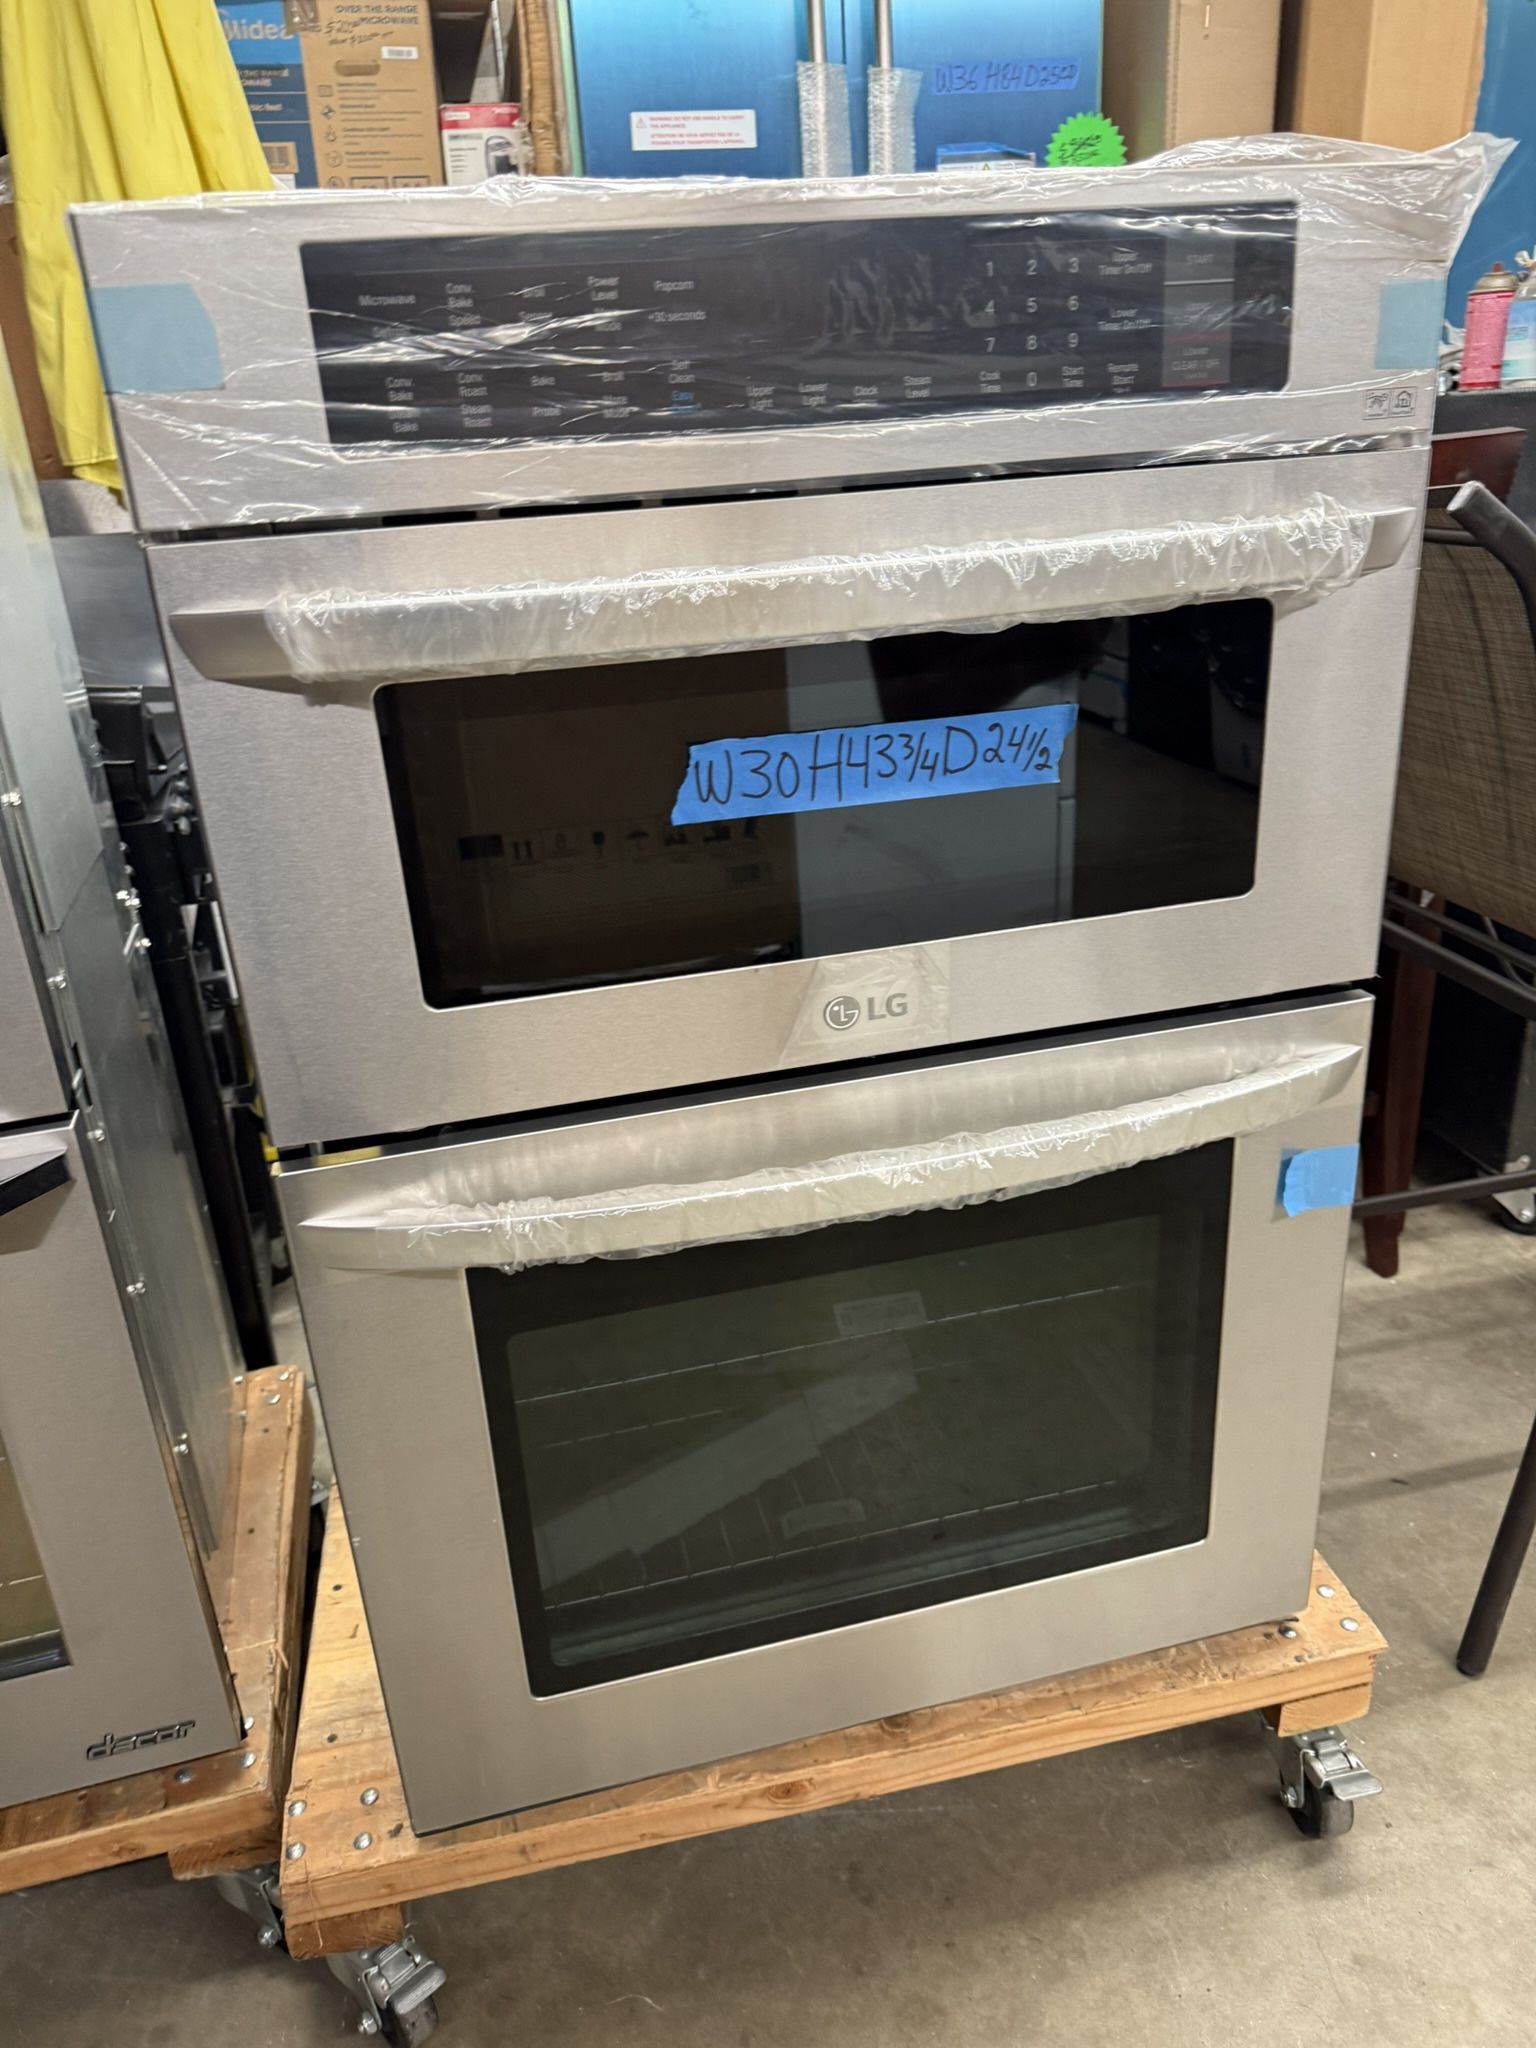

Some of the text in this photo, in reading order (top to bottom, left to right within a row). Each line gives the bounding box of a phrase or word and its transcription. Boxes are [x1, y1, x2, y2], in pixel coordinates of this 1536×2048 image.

[985, 257, 1080, 277] 1 2 3
[587, 276, 619, 287] Power
[654, 281, 695, 292] Popcorn
[358, 295, 416, 306] Microwave
[590, 289, 618, 301] Level
[448, 297, 474, 307] Bake
[984, 295, 1080, 313] 4 5 6
[668, 309, 707, 322] seconds
[984, 332, 1080, 352] 7 8 9
[385, 376, 415, 388] Conv.
[530, 376, 556, 387] Bake
[1026, 371, 1038, 387] 0
[388, 390, 414, 401] Bake
[853, 385, 878, 396] Clock
[905, 388, 931, 398] Level
[532, 406, 561, 417] Probe
[866, 993, 909, 1021] LG
[86, 1719, 197, 1761] dacor
